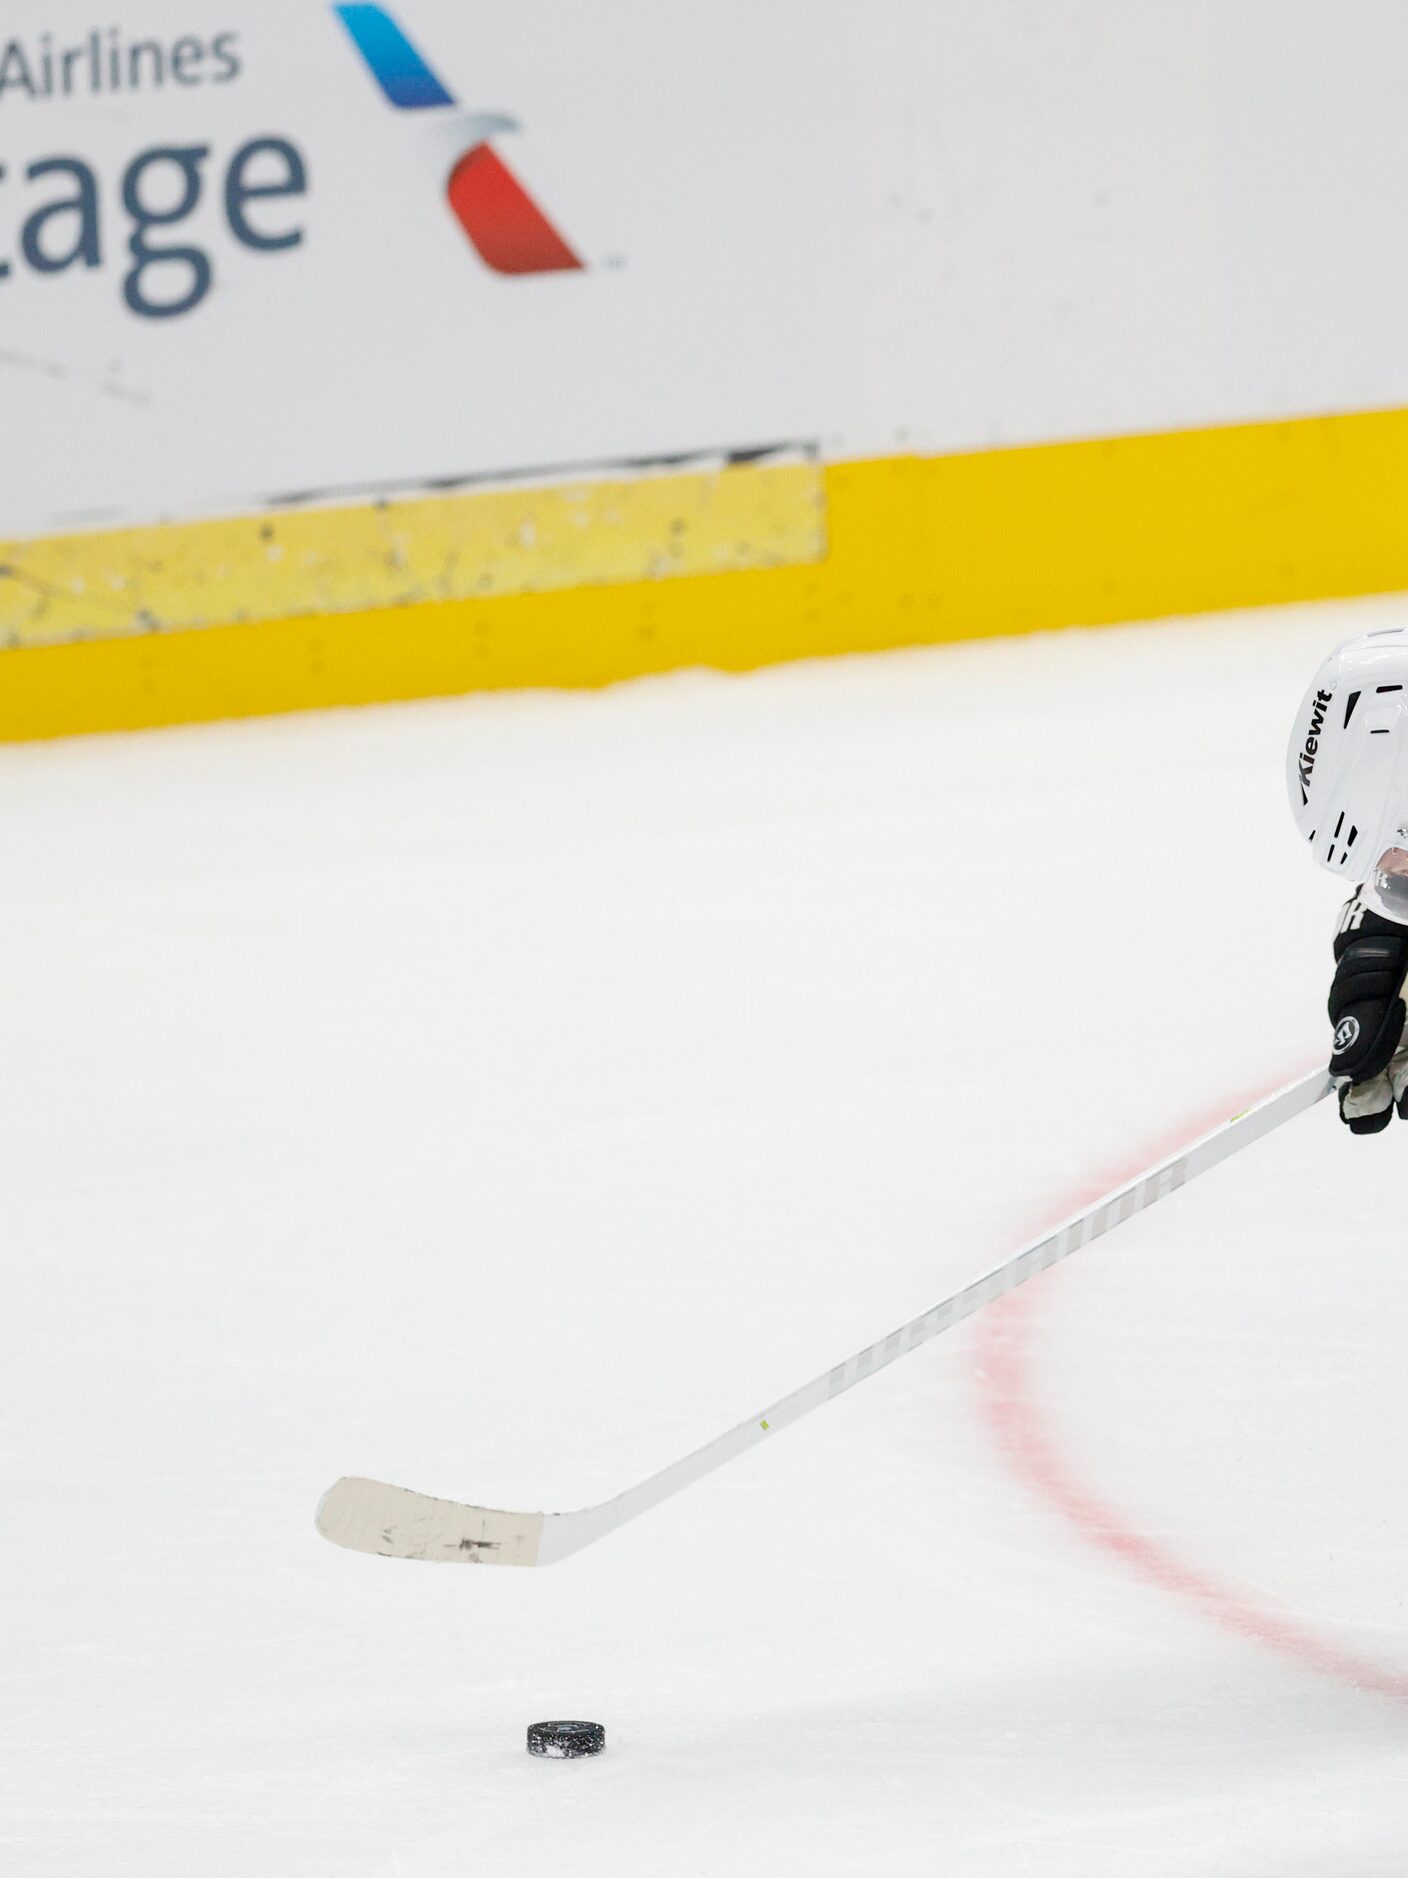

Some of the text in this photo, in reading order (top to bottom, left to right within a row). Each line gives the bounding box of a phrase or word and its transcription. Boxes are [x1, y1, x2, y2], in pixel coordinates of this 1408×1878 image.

[0, 29, 242, 99] Airlines
[0, 132, 309, 321] age
[1299, 689, 1332, 788] Kiewit
